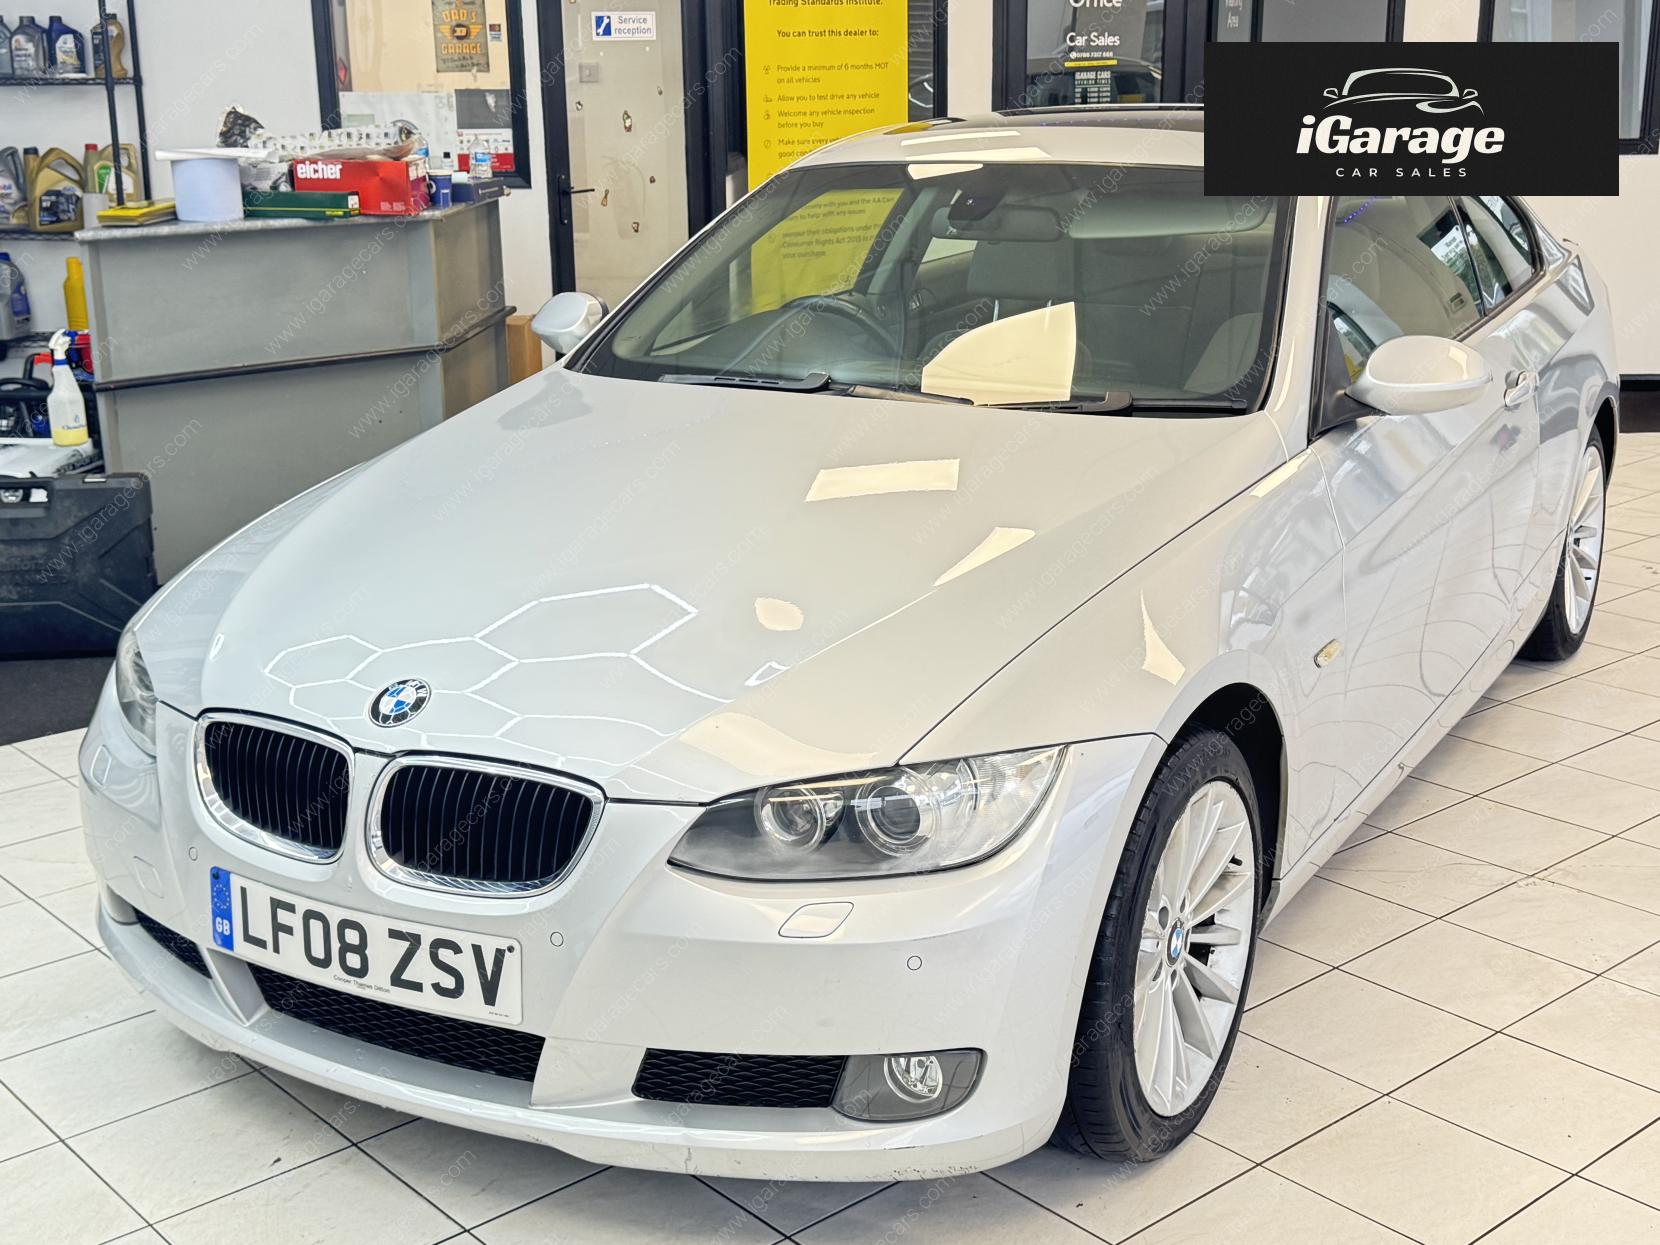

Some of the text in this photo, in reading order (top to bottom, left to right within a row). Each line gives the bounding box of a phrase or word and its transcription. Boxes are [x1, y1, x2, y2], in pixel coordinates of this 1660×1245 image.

[618, 15, 648, 25] Service
[614, 26, 652, 37] reception
[777, 29, 791, 38] You
[808, 29, 826, 38] trust
[828, 28, 842, 37] this
[843, 28, 868, 37] dealer
[869, 28, 880, 37] to:
[1066, 32, 1120, 46] Car Sales
[441, 43, 481, 55] GARAGE
[777, 64, 801, 72] Provide
[844, 63, 849, 71] 6
[875, 62, 889, 70] MOT
[843, 108, 875, 116] inspection
[778, 121, 798, 129] before
[812, 120, 824, 128] buy
[778, 151, 795, 160] good
[296, 160, 343, 180] eicher
[215, 916, 231, 936] GB
[239, 885, 507, 1008] LF08 ZSV
